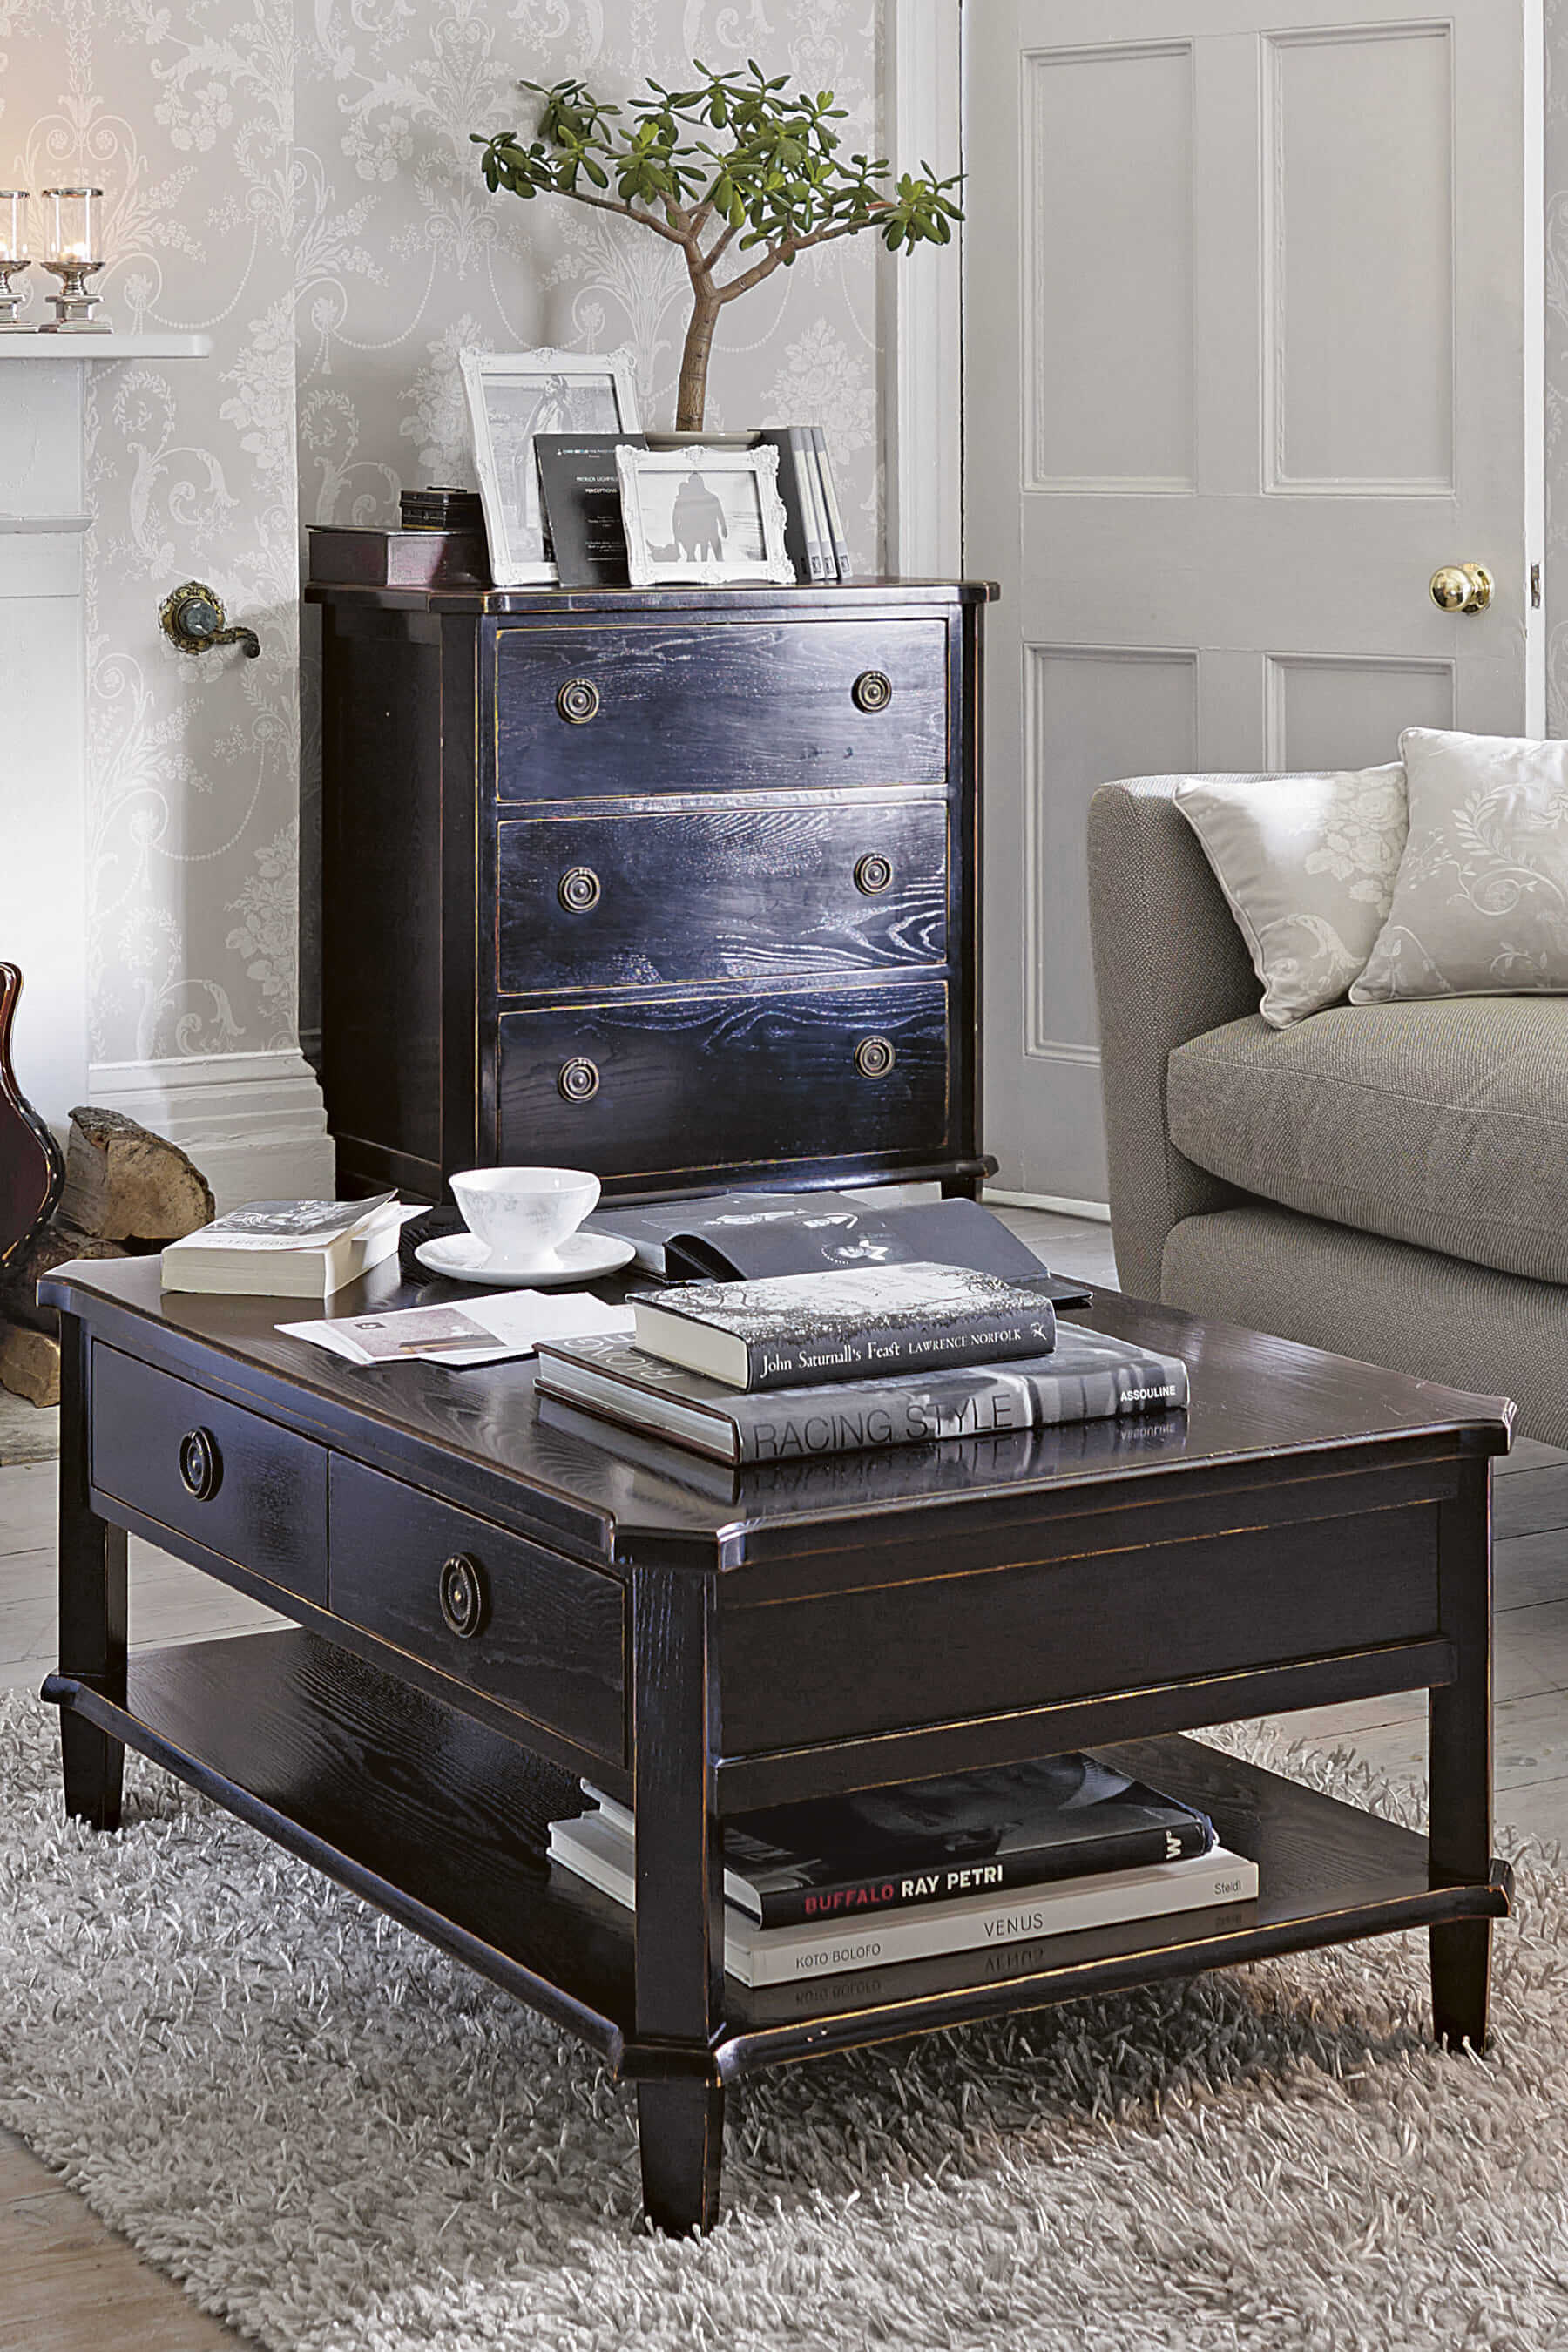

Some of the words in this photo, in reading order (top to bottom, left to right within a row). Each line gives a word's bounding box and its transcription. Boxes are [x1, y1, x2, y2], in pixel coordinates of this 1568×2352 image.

[760, 1353, 792, 1379] John
[799, 1344, 862, 1369] Saturnall's
[868, 1342, 900, 1360] Feast
[909, 1335, 967, 1354] LAWRENCE
[971, 1328, 1022, 1345] NORFOLK
[1120, 1384, 1177, 1402] ASSOULINE
[754, 1408, 893, 1459] RACING
[906, 1394, 1013, 1438] STYLE
[805, 1883, 894, 1915] BUFFALO
[901, 1875, 940, 1898] RAY
[947, 1864, 1004, 1890] PETRI
[1213, 1879, 1241, 1895] Steidl
[983, 1913, 1044, 1938] VENUS
[795, 1952, 828, 1970] KOTO
[832, 1943, 881, 1962] BOLOFO
